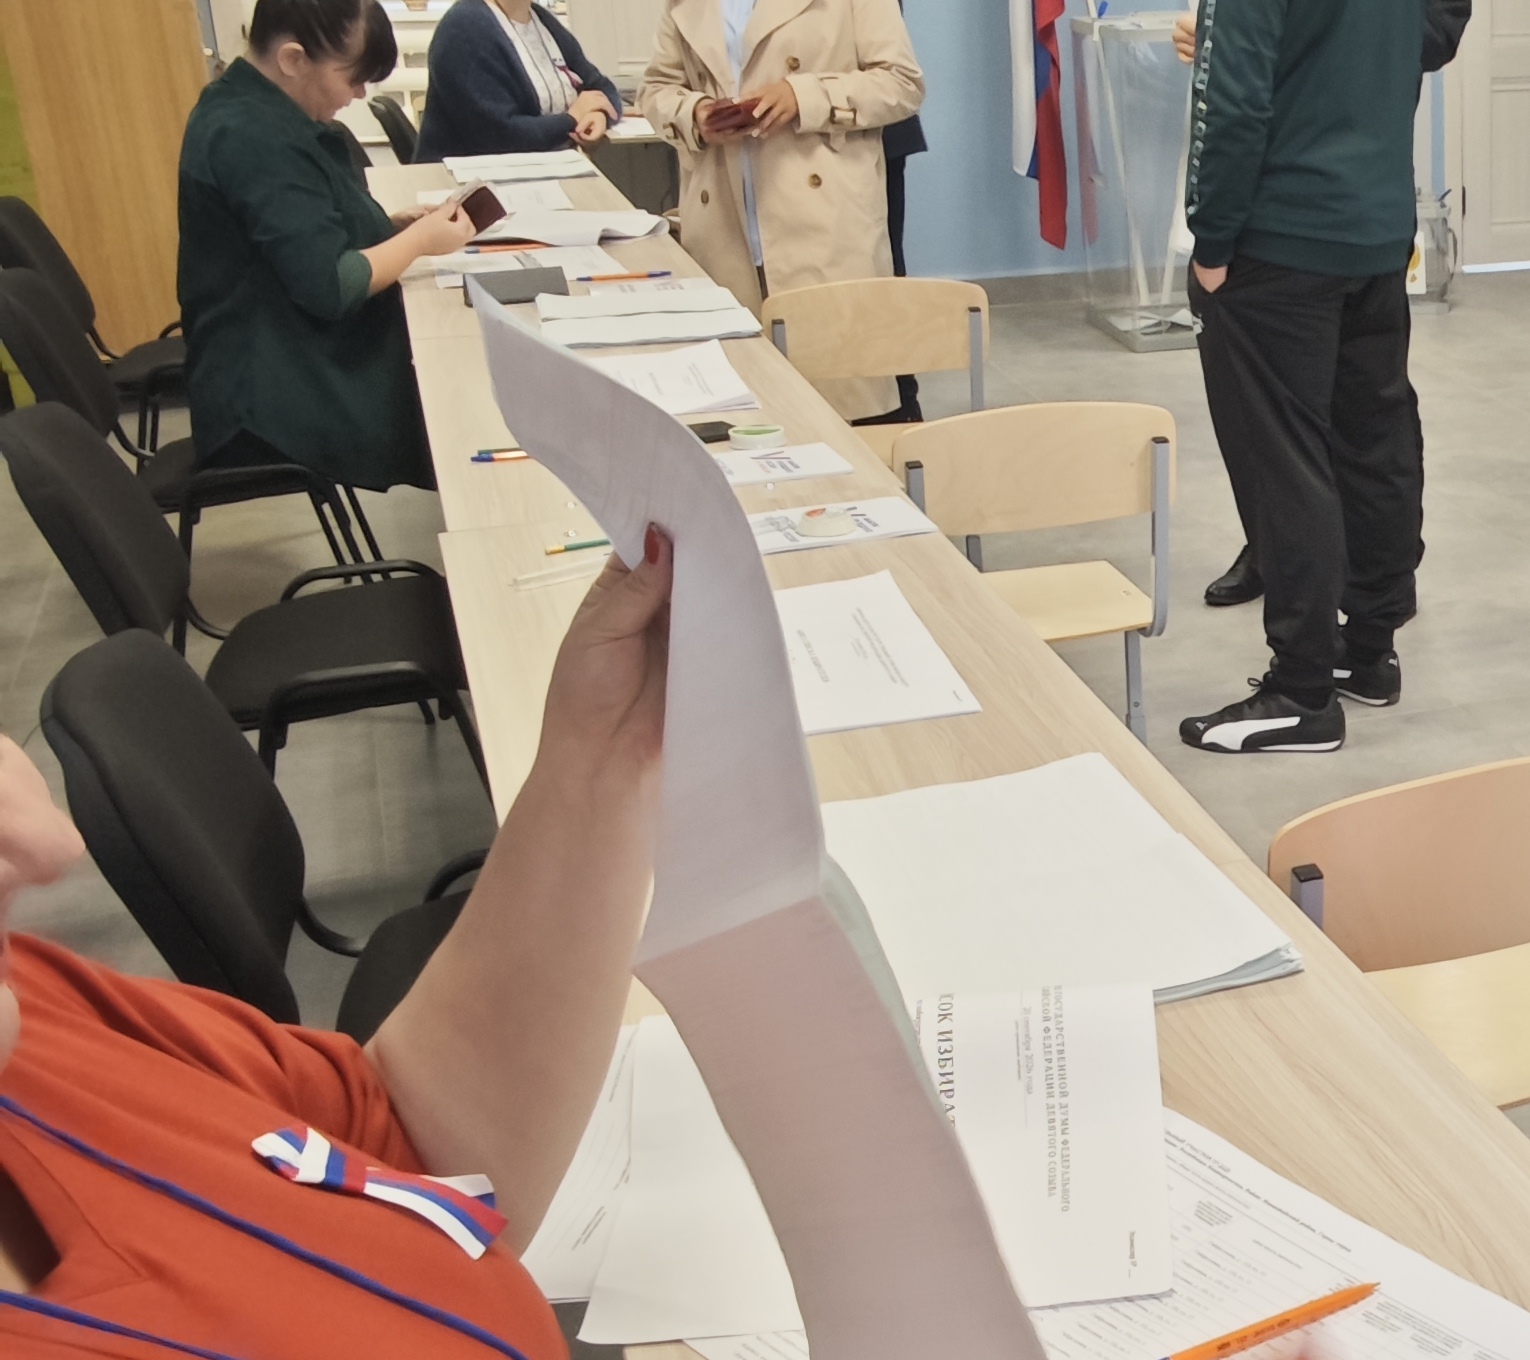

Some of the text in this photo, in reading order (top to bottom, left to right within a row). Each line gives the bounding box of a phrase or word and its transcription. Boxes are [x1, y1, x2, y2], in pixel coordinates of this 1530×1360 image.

[937, 992, 954, 1024] СОК
[1043, 1026, 1054, 1099] ФЕДЕРАЦИИ
[1046, 1102, 1056, 1158] ДЕВЯТОГО
[1059, 1102, 1069, 1136] ДУМЫ
